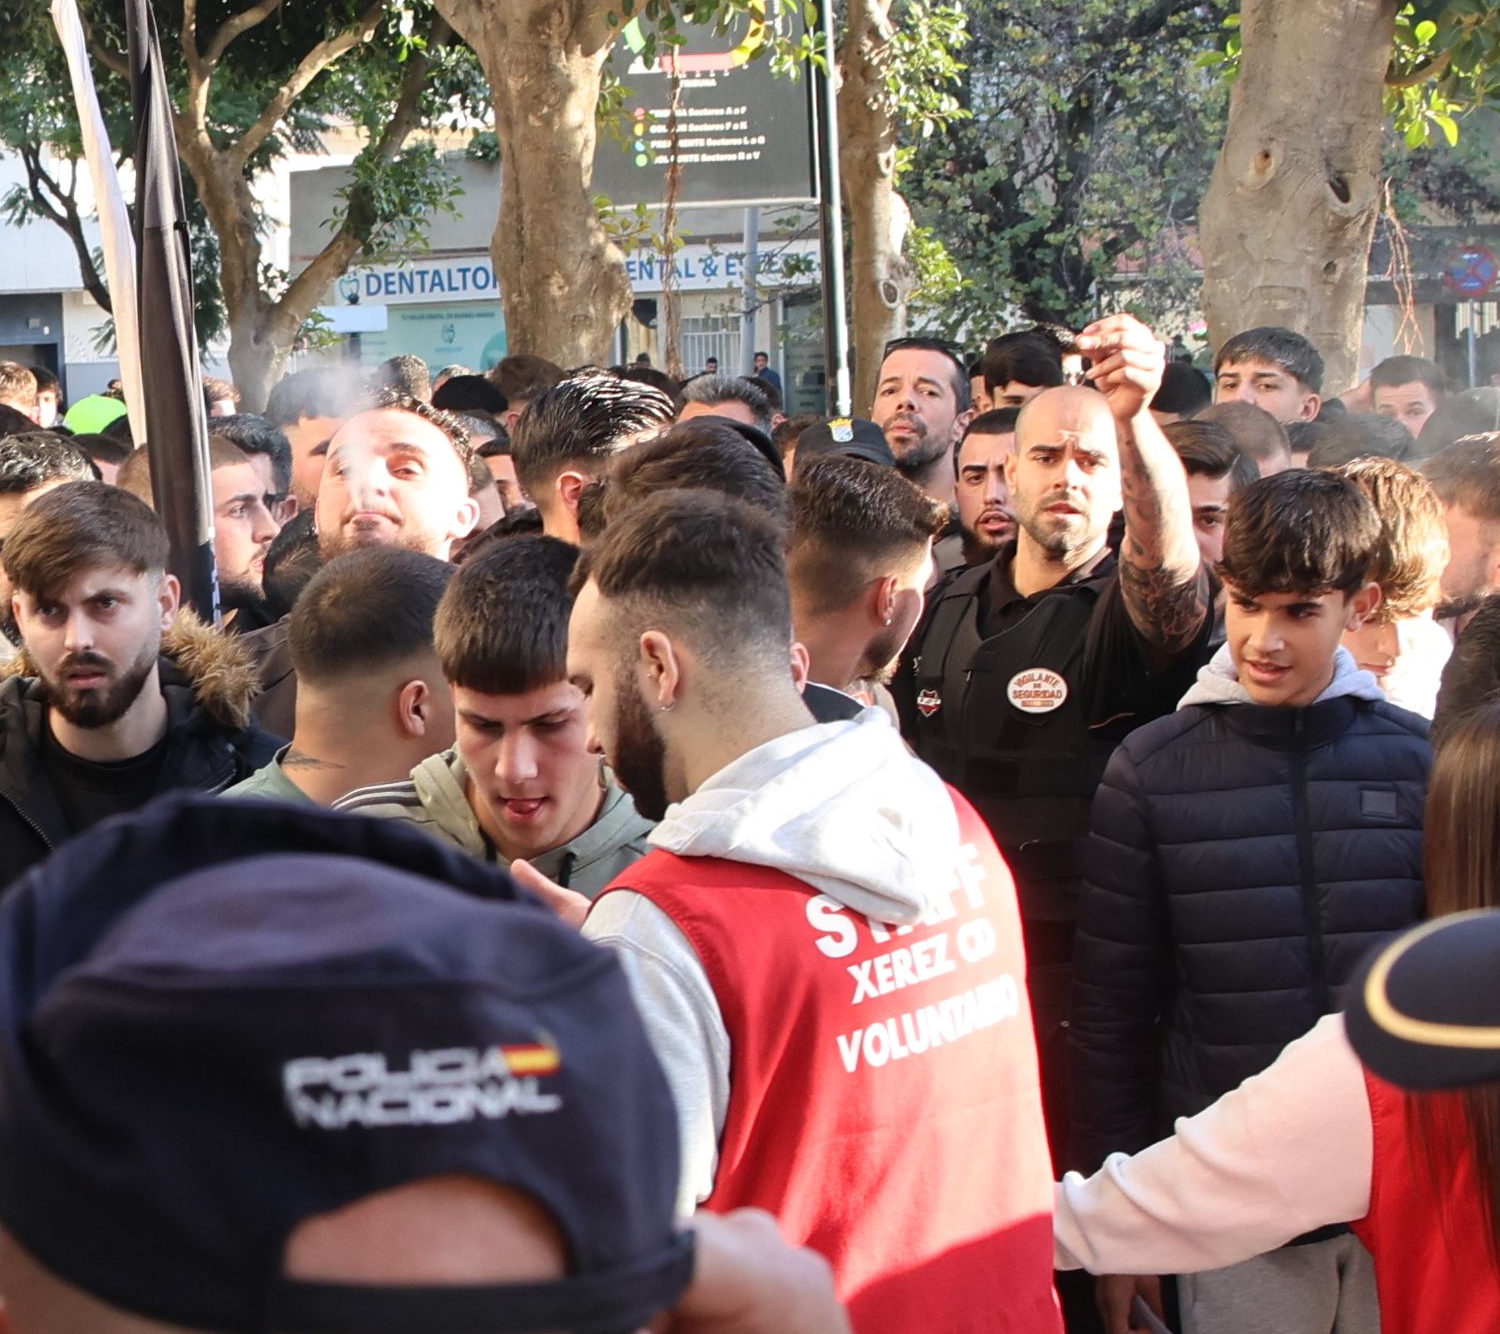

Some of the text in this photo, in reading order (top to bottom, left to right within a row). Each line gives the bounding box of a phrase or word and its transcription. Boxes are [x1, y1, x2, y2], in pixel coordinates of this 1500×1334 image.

[702, 255, 718, 278] &
[1012, 689, 1063, 700] SEGURIDAD
[846, 933, 957, 1006] XEREZ
[837, 974, 1019, 1074] VOLUNTARIO
[283, 1046, 510, 1092] POLICIA
[286, 1076, 563, 1130] NACIONAL
